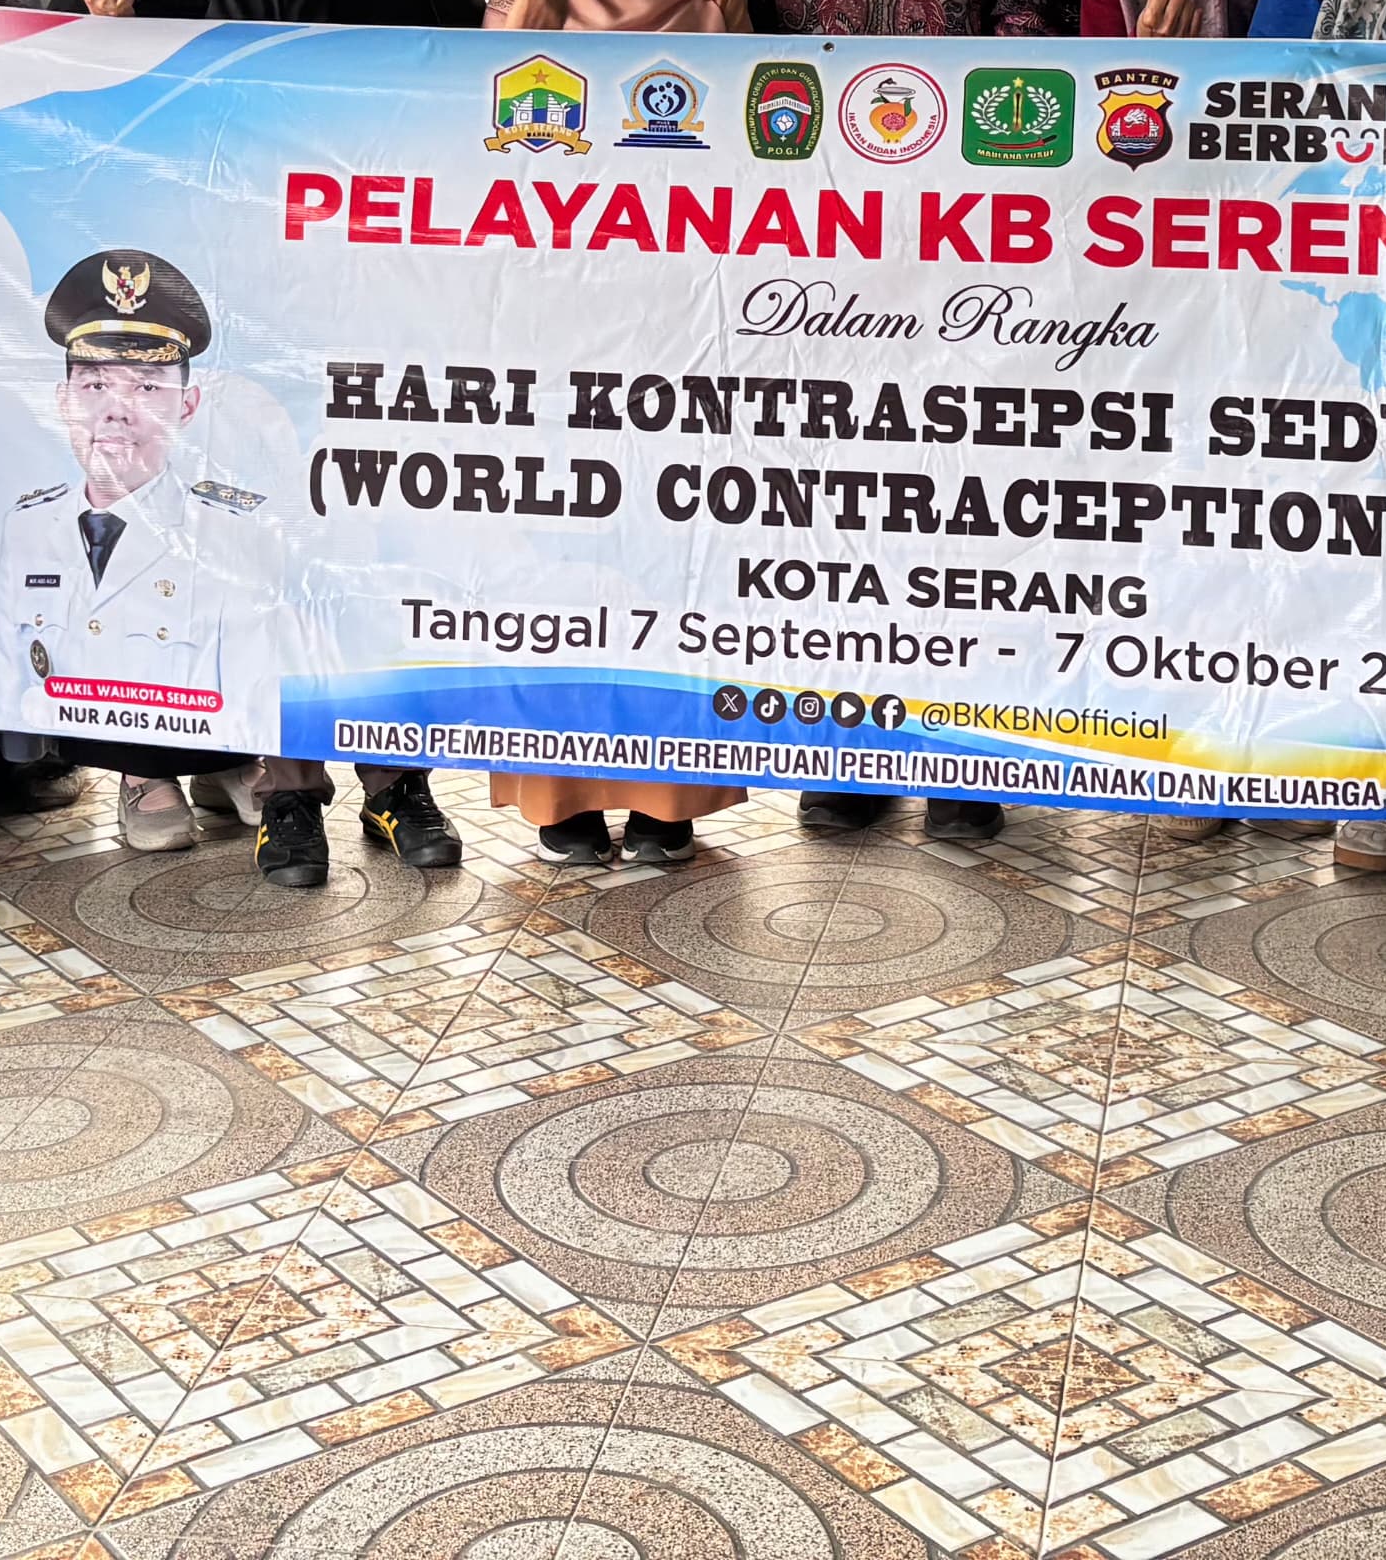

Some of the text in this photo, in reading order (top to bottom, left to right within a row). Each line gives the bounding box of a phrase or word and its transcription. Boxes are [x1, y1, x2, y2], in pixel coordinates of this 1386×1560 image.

[780, 67, 798, 75] DAN
[1100, 72, 1173, 88] BANTEN
[848, 112, 938, 155] IKATAN BIDAN INDONESIA
[284, 171, 884, 260] PELAYANAN
[919, 190, 1054, 265] KB
[735, 277, 1159, 372] Dalam Rangka
[325, 361, 538, 427] HARI
[567, 370, 1175, 453] KONTRASEPSI
[309, 446, 623, 519] (WORLD
[737, 557, 1149, 619] KOTA SERANG
[401, 598, 608, 653] Tanggal
[629, 609, 659, 651] 7
[677, 610, 978, 668] September
[1054, 632, 1085, 673] 7
[1105, 633, 1340, 693] Oktober
[50, 681, 218, 709] WAKIL WALIKOTA SERANG
[59, 705, 212, 736] NUR AGIS AULIA
[920, 700, 1168, 741] @BKKBNOfficial
[338, 722, 418, 752] DINAS
[429, 727, 649, 766] PEMBERDAYAAN
[659, 741, 830, 775] PEREMPUAN
[840, 753, 1061, 792] PERLINDUNGAN
[1070, 767, 1147, 798] ANAK
[1158, 772, 1215, 801] DAN
[1227, 776, 1379, 807] KELUARGA
